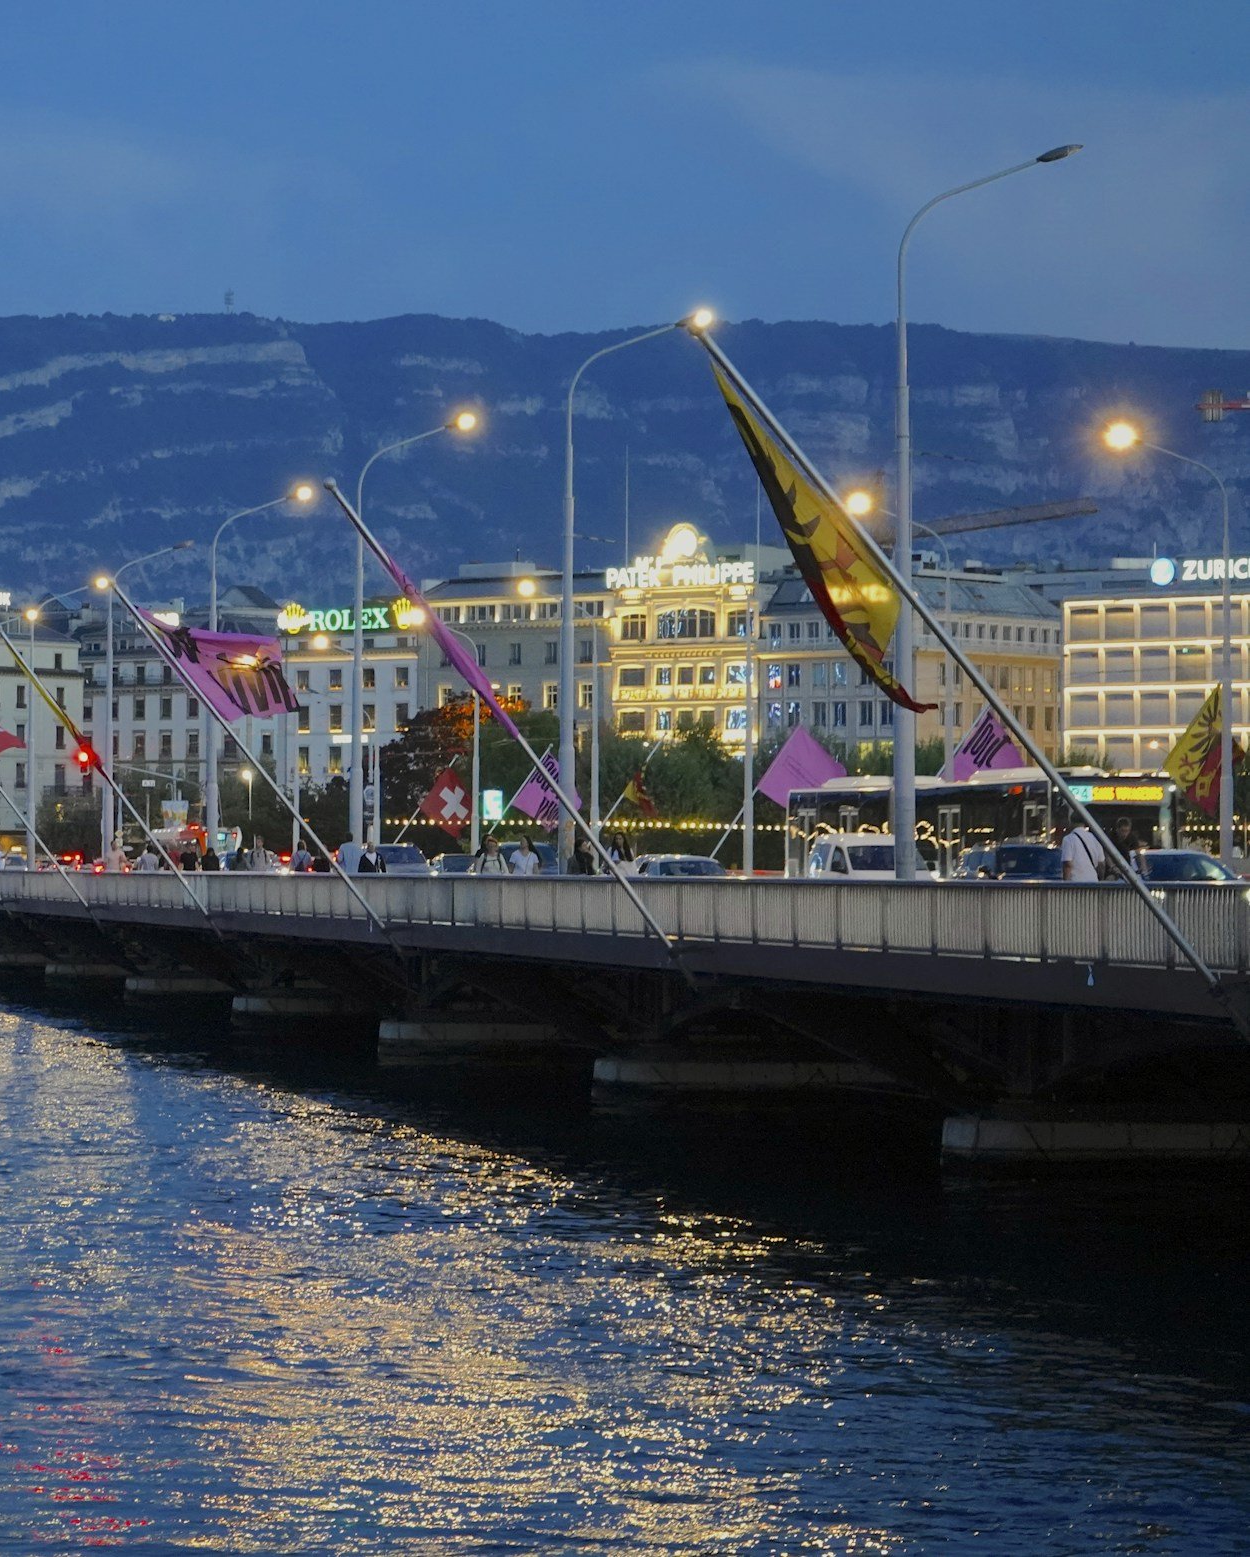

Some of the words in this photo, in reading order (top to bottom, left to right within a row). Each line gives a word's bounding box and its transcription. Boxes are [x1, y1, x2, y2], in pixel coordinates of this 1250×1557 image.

[606, 565, 662, 589] PATEK
[672, 561, 755, 587] PHILIPPE
[1182, 558, 1250, 580] ZURIC
[308, 607, 390, 631] ROLEX
